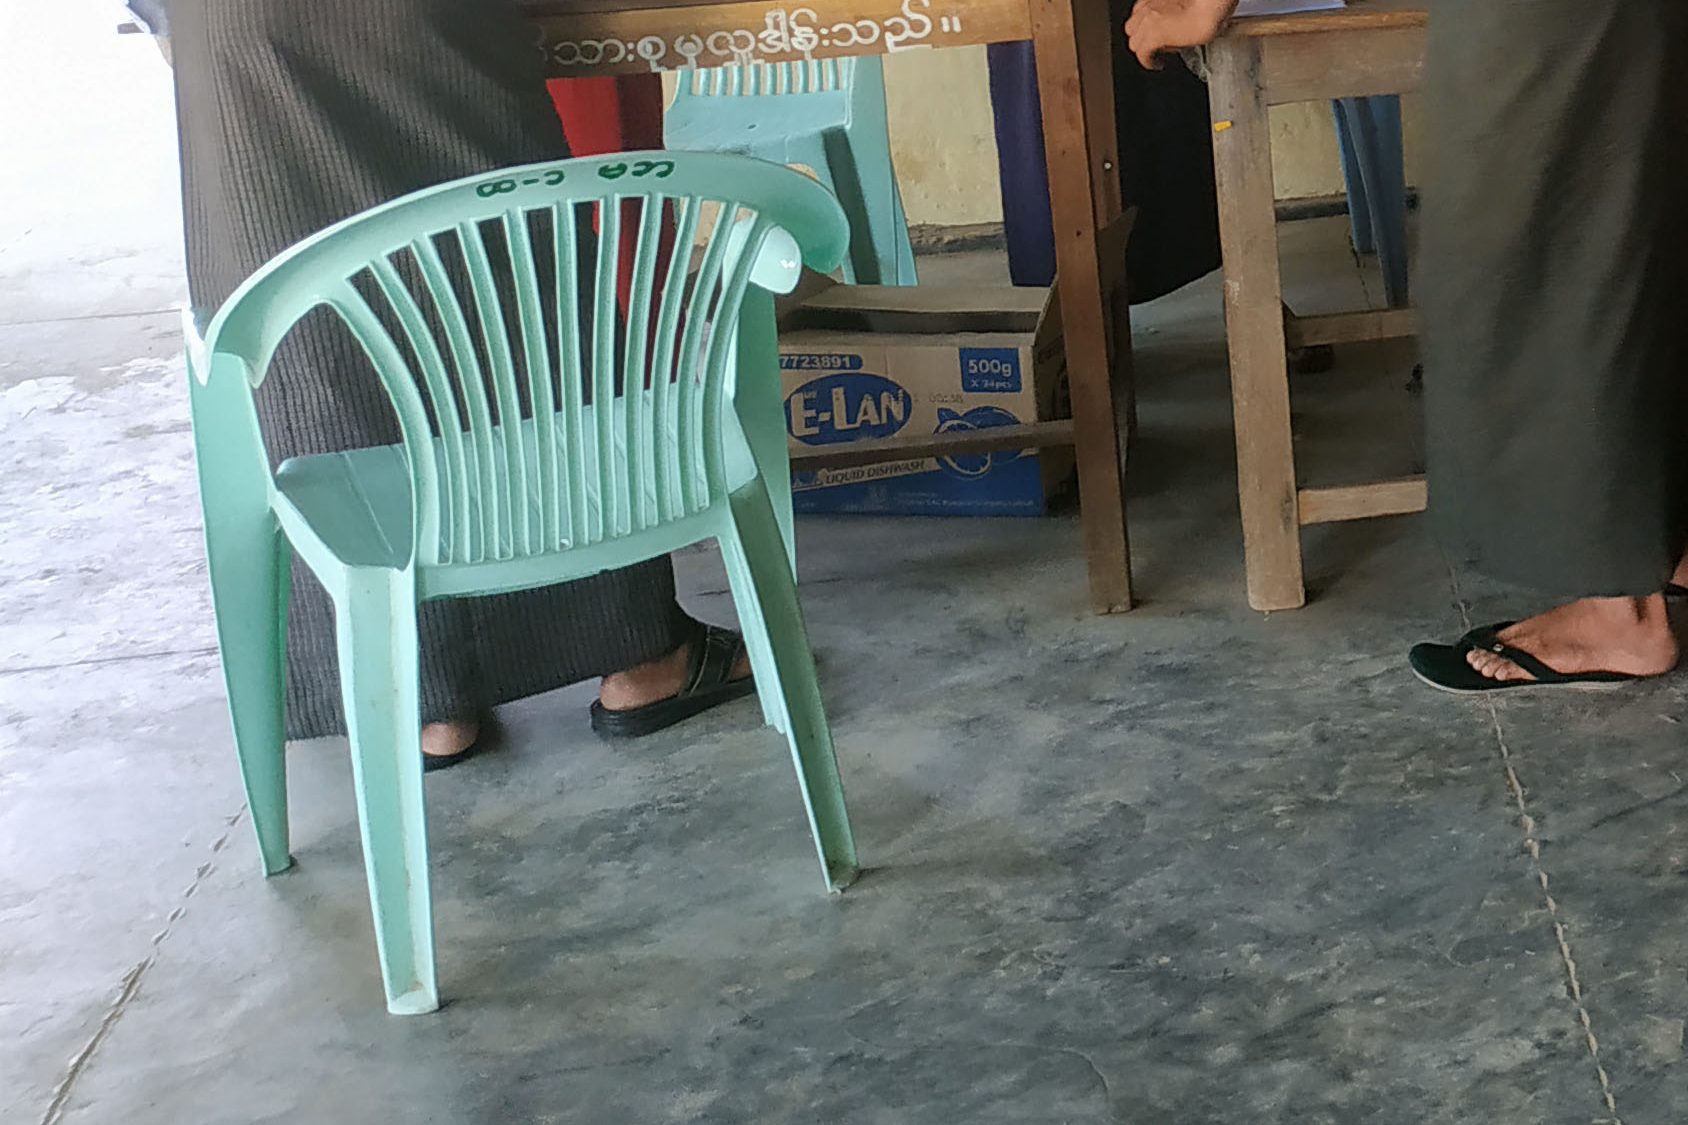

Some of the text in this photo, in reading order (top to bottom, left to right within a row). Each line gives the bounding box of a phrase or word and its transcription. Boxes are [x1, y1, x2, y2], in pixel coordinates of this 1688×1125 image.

[779, 355, 851, 369] 7723891
[968, 359, 1012, 378] 500g
[825, 460, 925, 485] LIQUID DISHWASH
